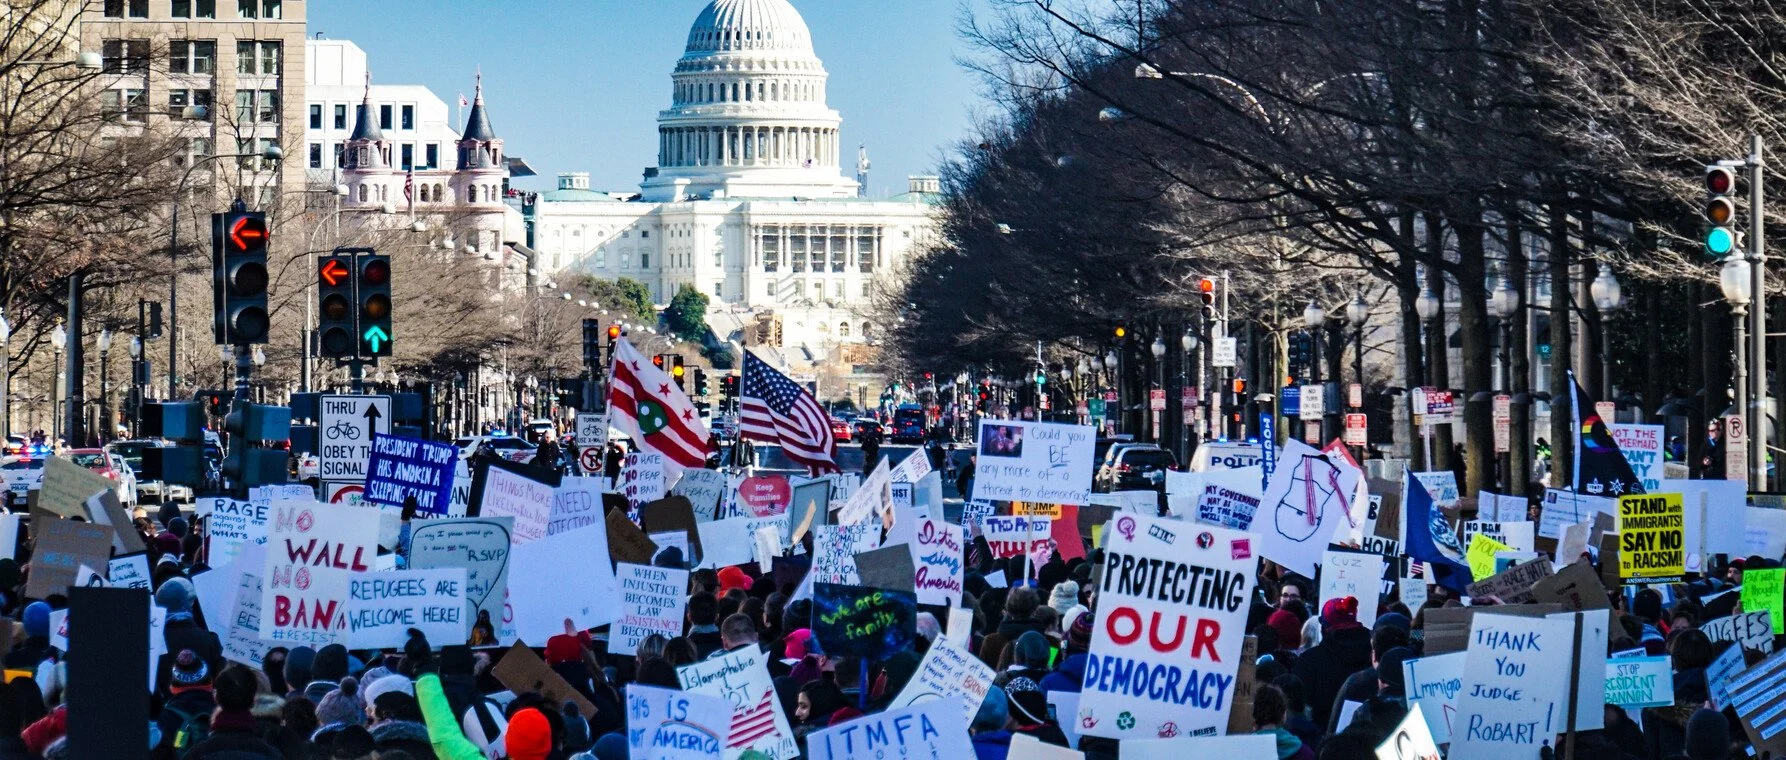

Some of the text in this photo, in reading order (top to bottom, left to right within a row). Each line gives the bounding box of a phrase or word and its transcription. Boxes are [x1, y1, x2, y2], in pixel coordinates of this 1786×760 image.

[326, 401, 356, 414] THRU
[1032, 427, 1086, 445] Could you
[1635, 430, 1656, 438] THE
[324, 446, 358, 458] OBEY
[375, 436, 452, 465] PRESIDENT TRUMP
[1618, 438, 1658, 450] MERMAID
[625, 454, 661, 468] NO HATE
[1049, 445, 1070, 463] BE
[324, 462, 366, 475] SIGNAL
[377, 459, 440, 486] HAS AWOKEN A
[626, 470, 660, 484] NO FEAR
[980, 464, 998, 477] any
[1004, 466, 1031, 477] more
[1038, 470, 1054, 481] of
[370, 480, 405, 502] SLEEPING
[490, 470, 552, 508] THINGS MORE
[626, 485, 658, 497] NO BAN
[756, 484, 774, 492] Keep
[892, 489, 908, 498] SIST
[982, 482, 1090, 504] threat to democracy?
[1206, 485, 1217, 494] MY
[555, 491, 591, 514] NEED
[750, 494, 781, 502] Families
[1207, 497, 1221, 505] MAY
[1622, 498, 1682, 515] STAND with
[215, 499, 269, 520] RAGE
[1233, 512, 1252, 522] WORLD
[212, 514, 246, 523] against
[212, 521, 234, 530] dying
[276, 507, 314, 532] NO
[548, 516, 596, 536] OTECTION
[1622, 515, 1682, 529] IMMIGRANTS!
[211, 530, 248, 540] WHAT'S
[824, 525, 867, 534] SUDANESE
[1466, 523, 1500, 532] NO BAN
[821, 542, 852, 550] YEMENI
[1623, 530, 1681, 552] SAY NO
[285, 538, 368, 573] WALL
[817, 557, 845, 566] IRAQI
[921, 552, 961, 576] sing
[1332, 556, 1362, 567] CUZ
[1623, 552, 1682, 569] to RACISM!
[272, 565, 312, 590] NO
[634, 568, 668, 581] WHEN
[820, 565, 858, 574] MEXICA
[1338, 570, 1345, 579] I
[1525, 559, 1549, 580] HATE
[351, 580, 460, 600] REFUGEES ARE
[623, 578, 679, 595] INJUSTICE
[625, 593, 676, 608] BECOMES
[855, 592, 884, 611] are
[274, 595, 337, 631] BAN
[350, 606, 460, 632] WELCOME HERE!
[638, 605, 662, 617] LAW
[1106, 606, 1222, 663] OUR
[1702, 612, 1770, 642] UGEES
[272, 630, 338, 643] #RESIST
[1476, 627, 1542, 651] THANK
[934, 637, 979, 674] Instead of
[680, 655, 755, 690] Islamophobia
[1496, 656, 1526, 677] YOU
[1617, 664, 1640, 676] STOP
[1085, 654, 1233, 711] DEMOCRACY
[1406, 659, 1462, 700] Immigra
[1604, 675, 1657, 690] RESIDENT
[1470, 684, 1523, 701] JUDGE
[1604, 690, 1654, 704] BANNON
[653, 727, 719, 756] AMERICA
